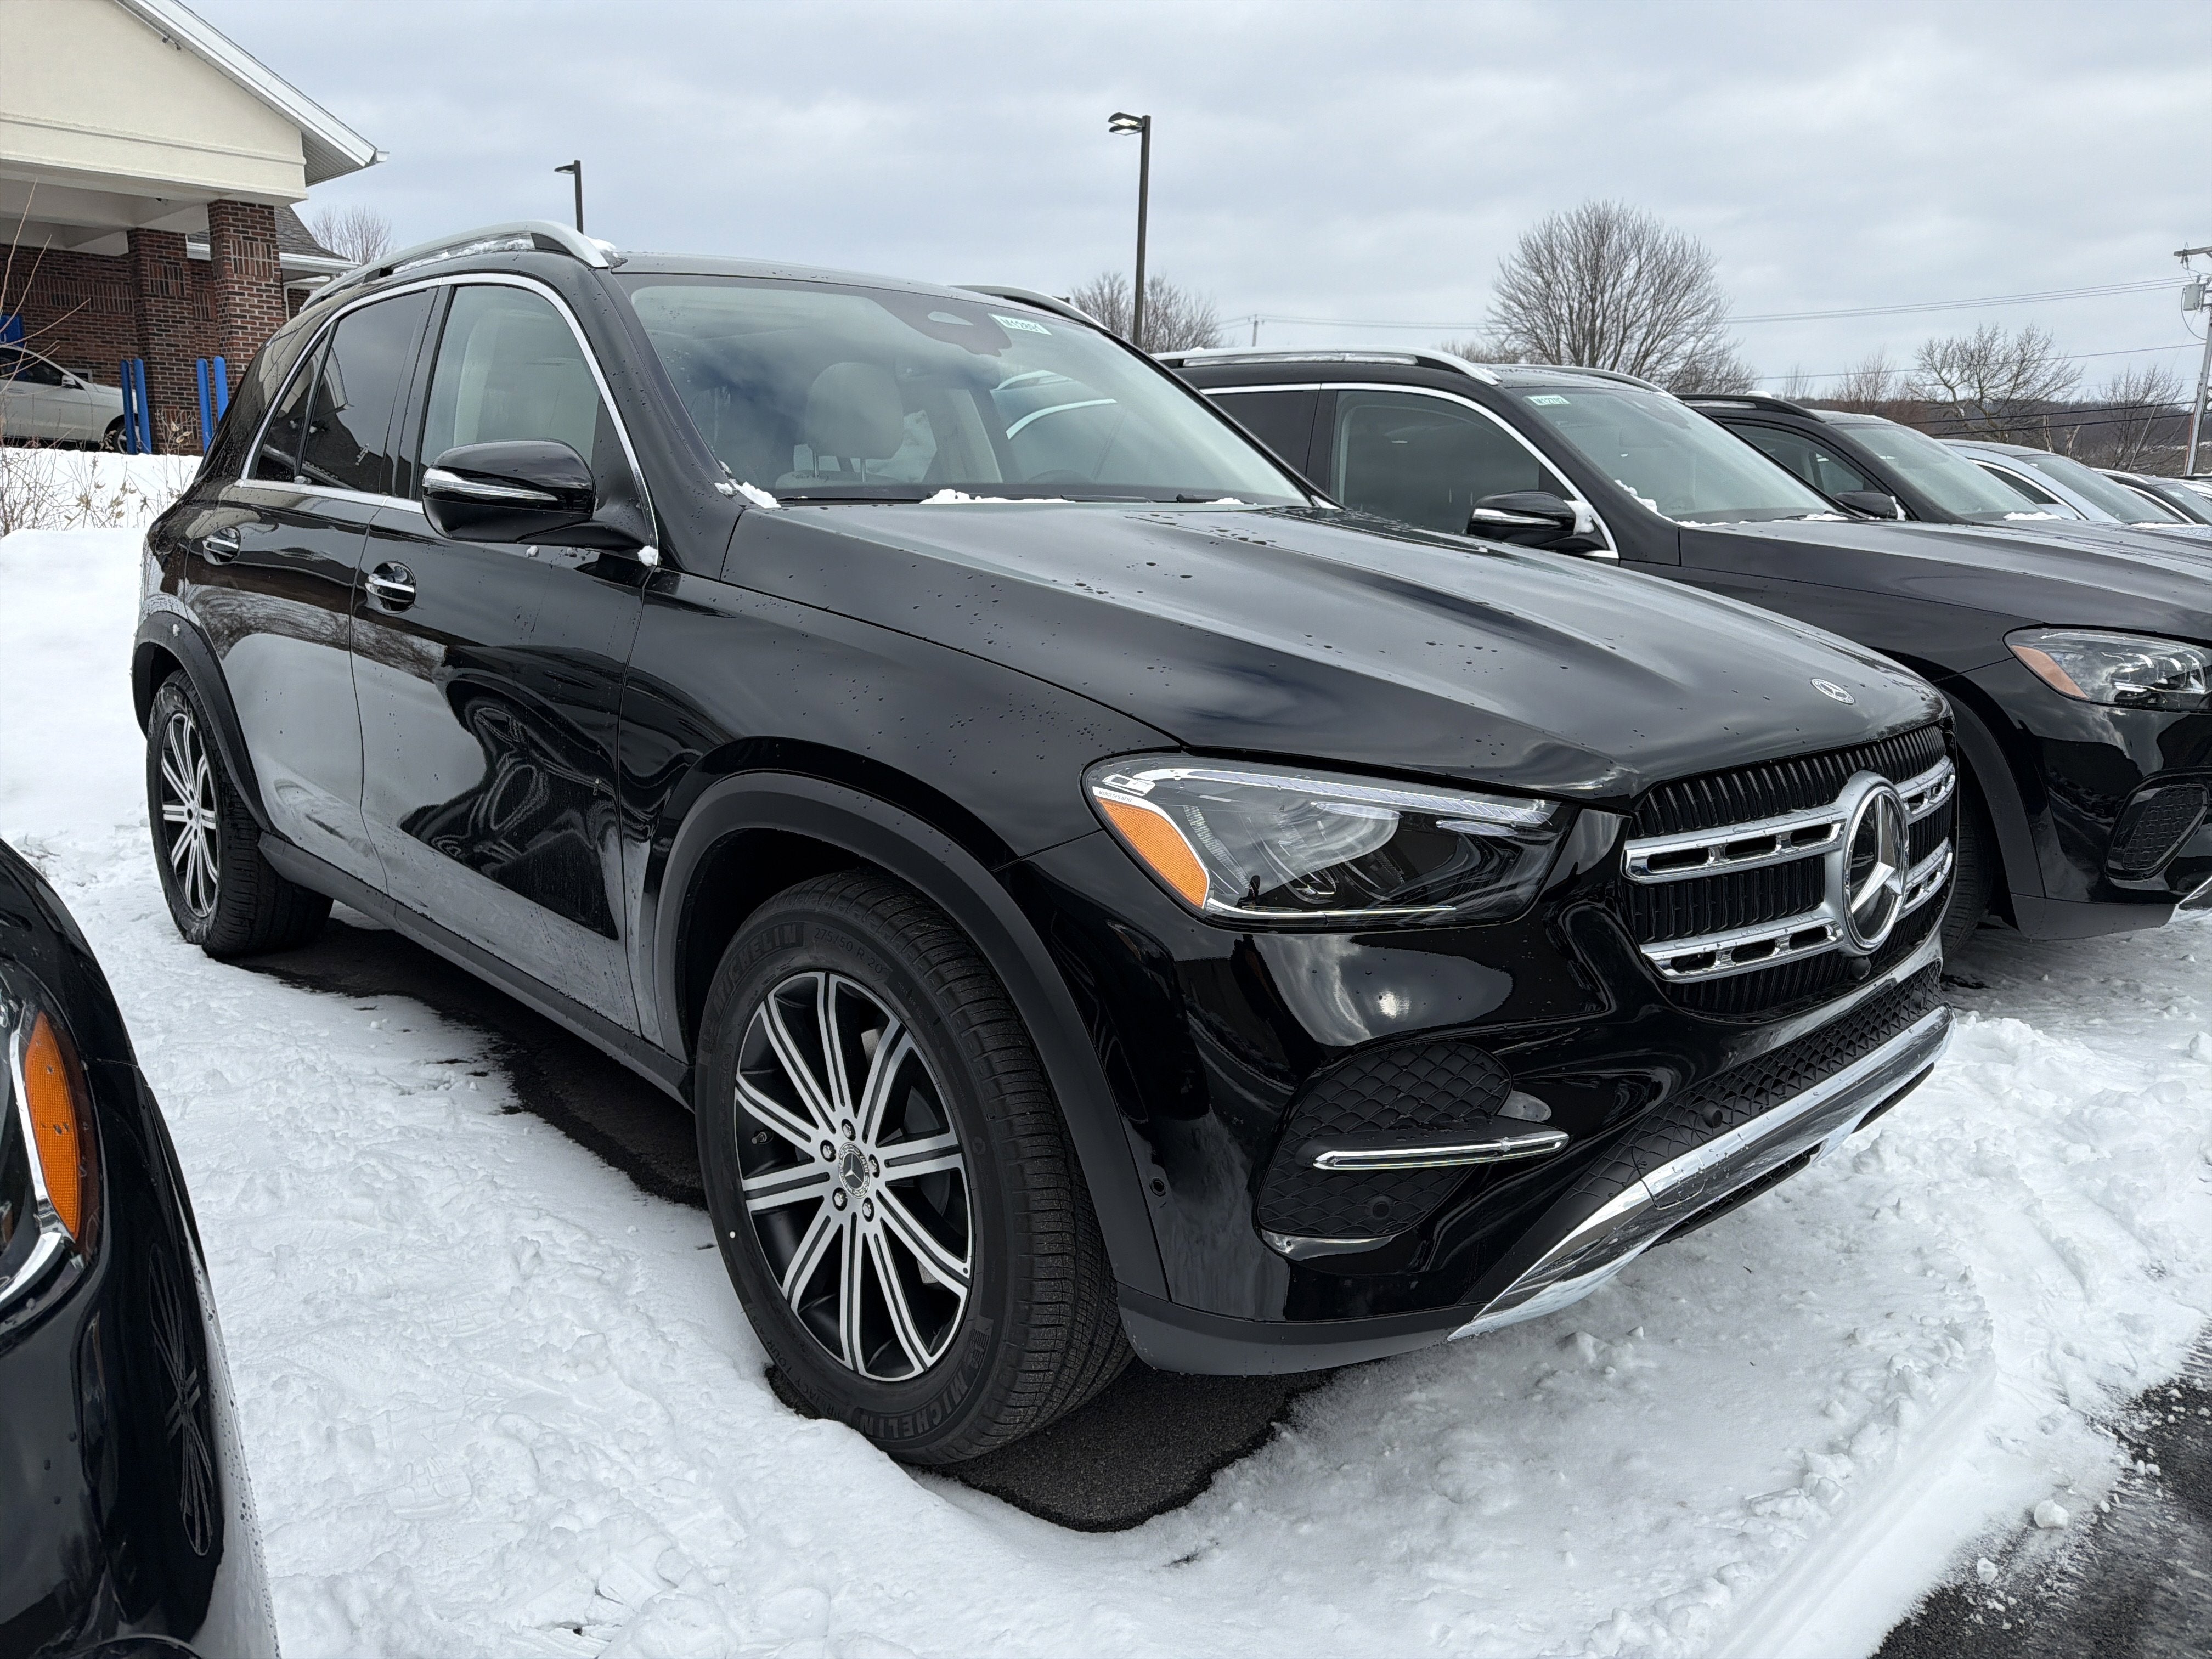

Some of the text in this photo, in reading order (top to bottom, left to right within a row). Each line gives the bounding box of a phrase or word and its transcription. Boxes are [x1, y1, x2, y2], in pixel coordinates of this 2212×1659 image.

[1098, 791, 1133, 802] MERCEDES-BENZ
[714, 924, 796, 1015] MICHELIN
[814, 928, 883, 973] 275/50 R 20
[766, 1339, 792, 1374] TOUR
[859, 1368, 968, 1438] MICHELIN
